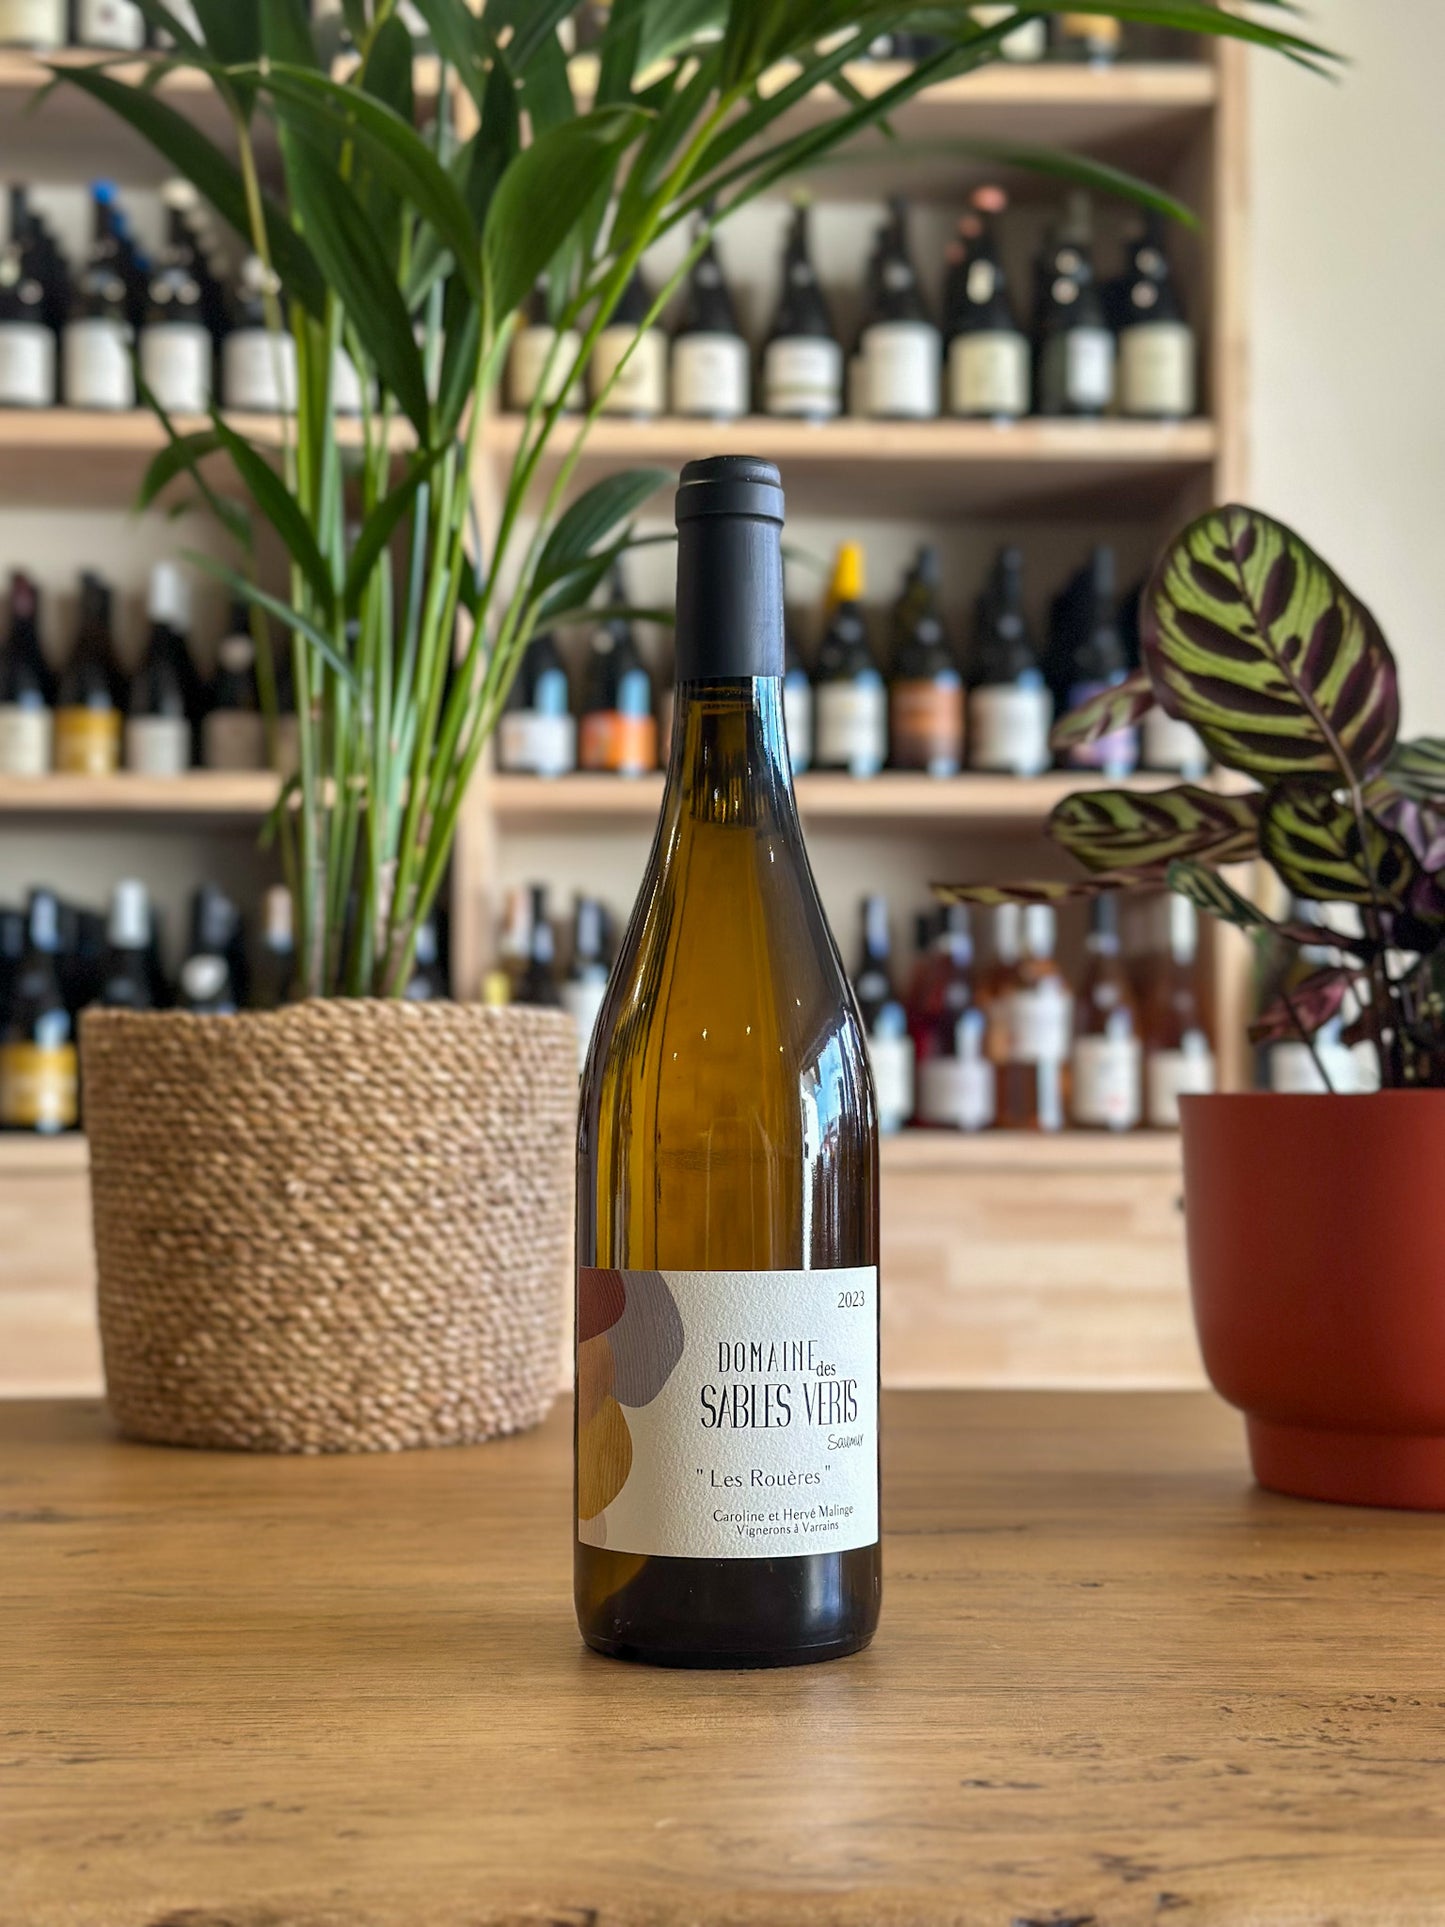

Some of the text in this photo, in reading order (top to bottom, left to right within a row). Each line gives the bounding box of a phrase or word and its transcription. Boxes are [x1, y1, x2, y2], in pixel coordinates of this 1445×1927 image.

[837, 1290, 865, 1308] 2023
[718, 1340, 837, 1377] DOMAINE des
[700, 1379, 858, 1429] SABLES VERTS
[827, 1433, 864, 1450] Saumur
[713, 1504, 854, 1523] Caroline et Hervé Malinge
[736, 1520, 839, 1538] Vignerons à Varrains
